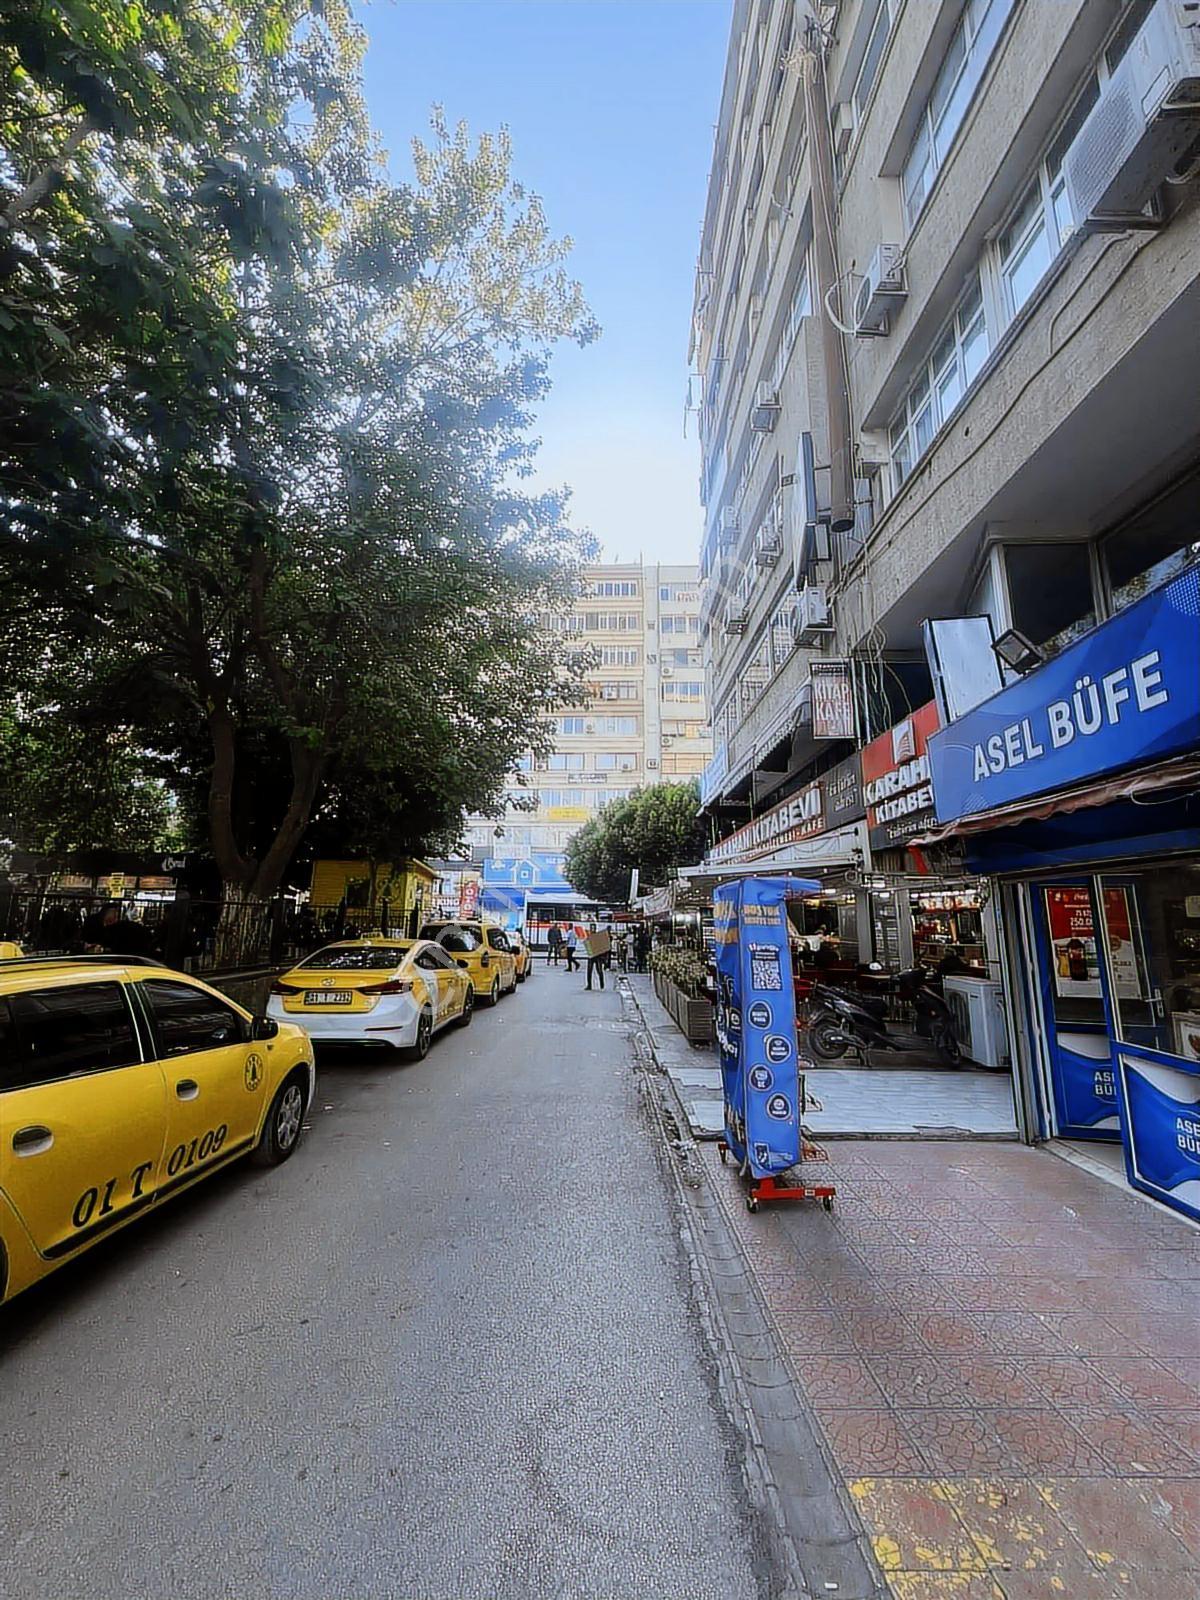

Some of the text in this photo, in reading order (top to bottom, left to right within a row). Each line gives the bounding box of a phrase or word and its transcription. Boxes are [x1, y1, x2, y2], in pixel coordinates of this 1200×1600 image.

[816, 701, 850, 721] KAFE
[973, 650, 1169, 782] ASEL BÜFE
[863, 755, 931, 807] KARAH
[72, 1123, 228, 1228] 01 T 0109
